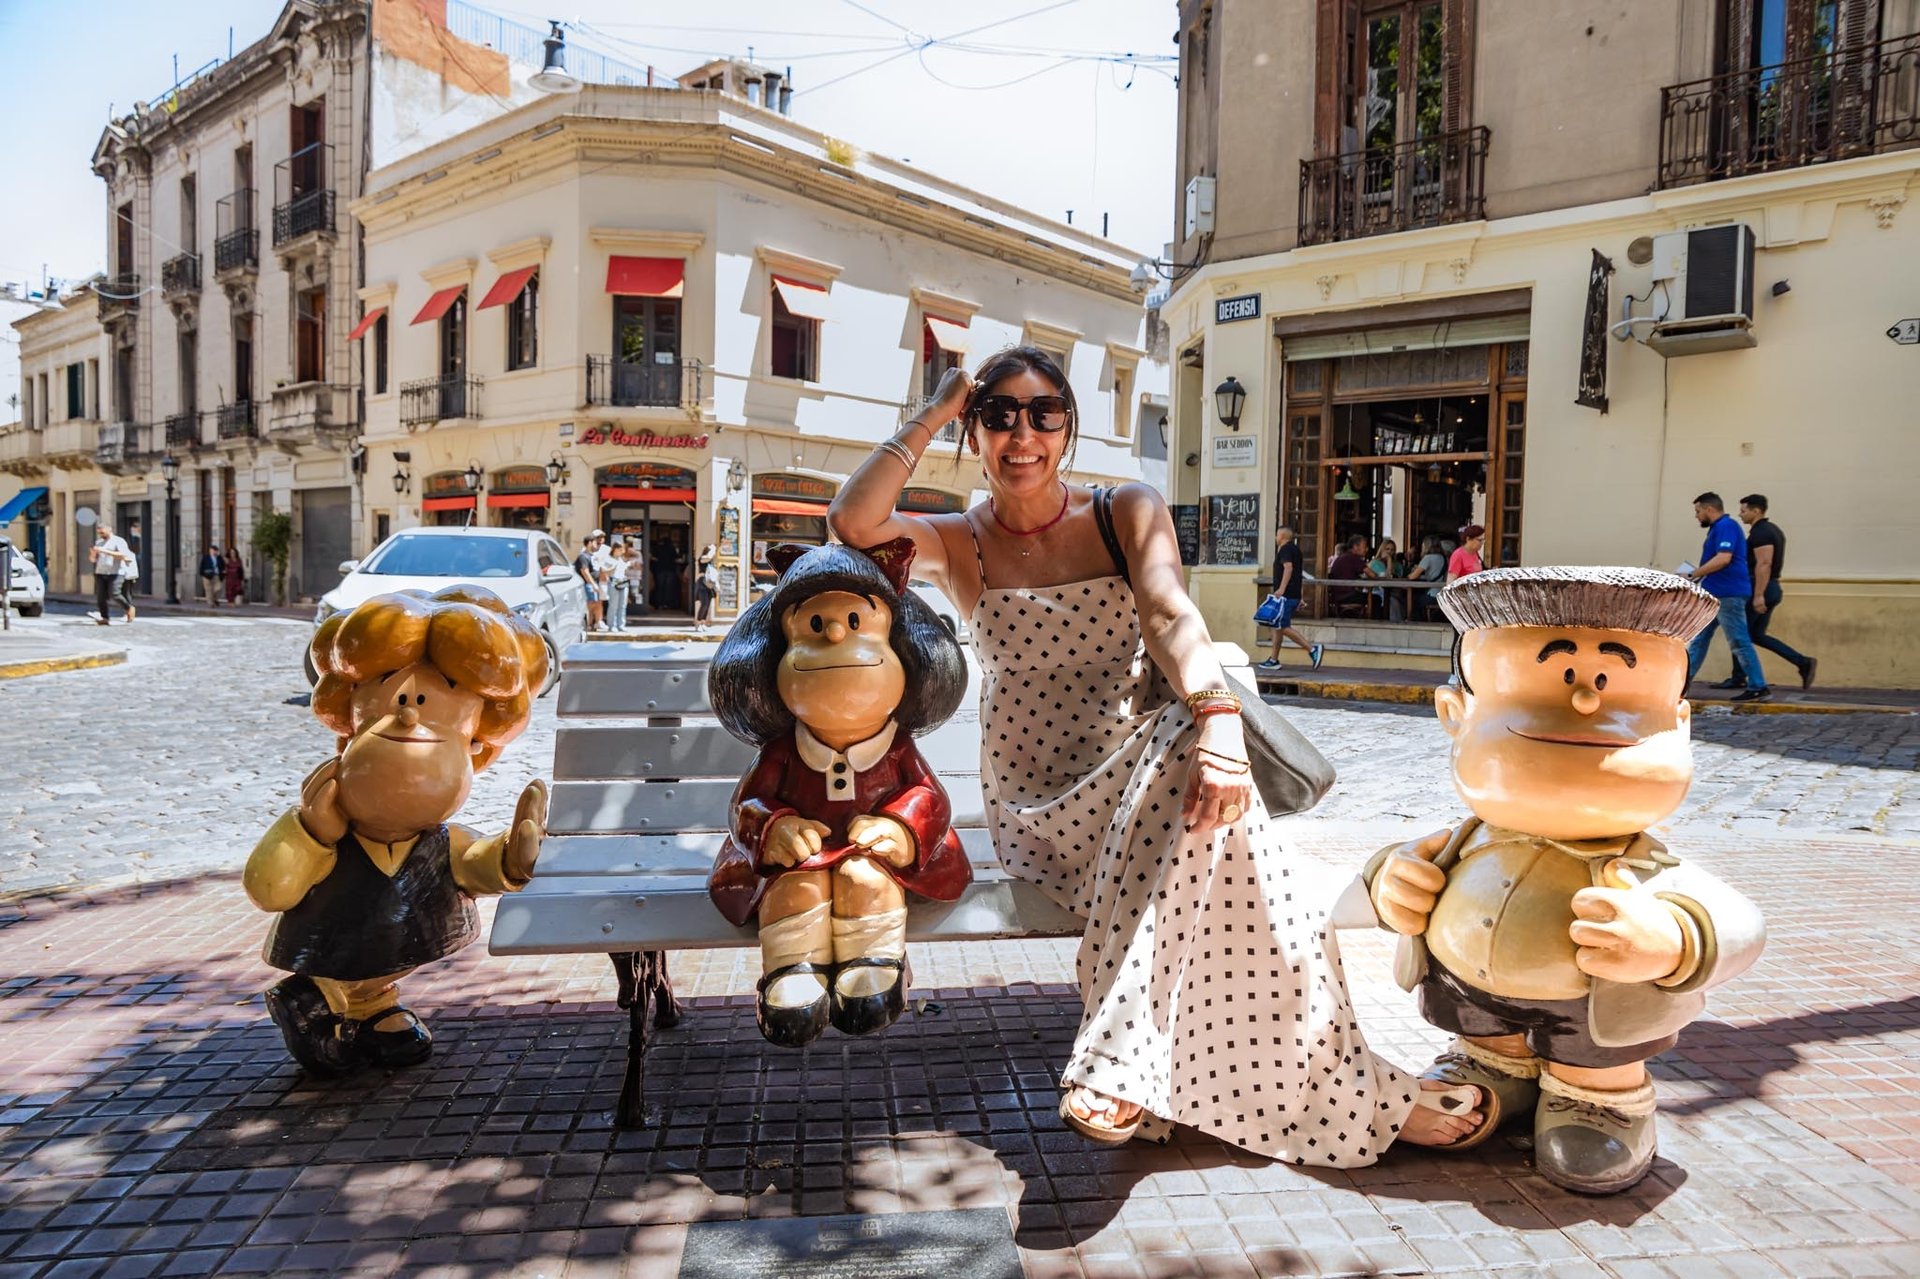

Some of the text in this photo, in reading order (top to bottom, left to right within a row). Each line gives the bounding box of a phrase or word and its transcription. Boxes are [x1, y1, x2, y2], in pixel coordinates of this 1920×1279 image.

[1219, 297, 1256, 321] DEFENSA
[576, 427, 605, 445] La
[609, 427, 710, 450] Continental
[1216, 439, 1229, 450] BAR
[1219, 496, 1257, 519] Menú
[858, 1268, 925, 1278] MANOLITO
